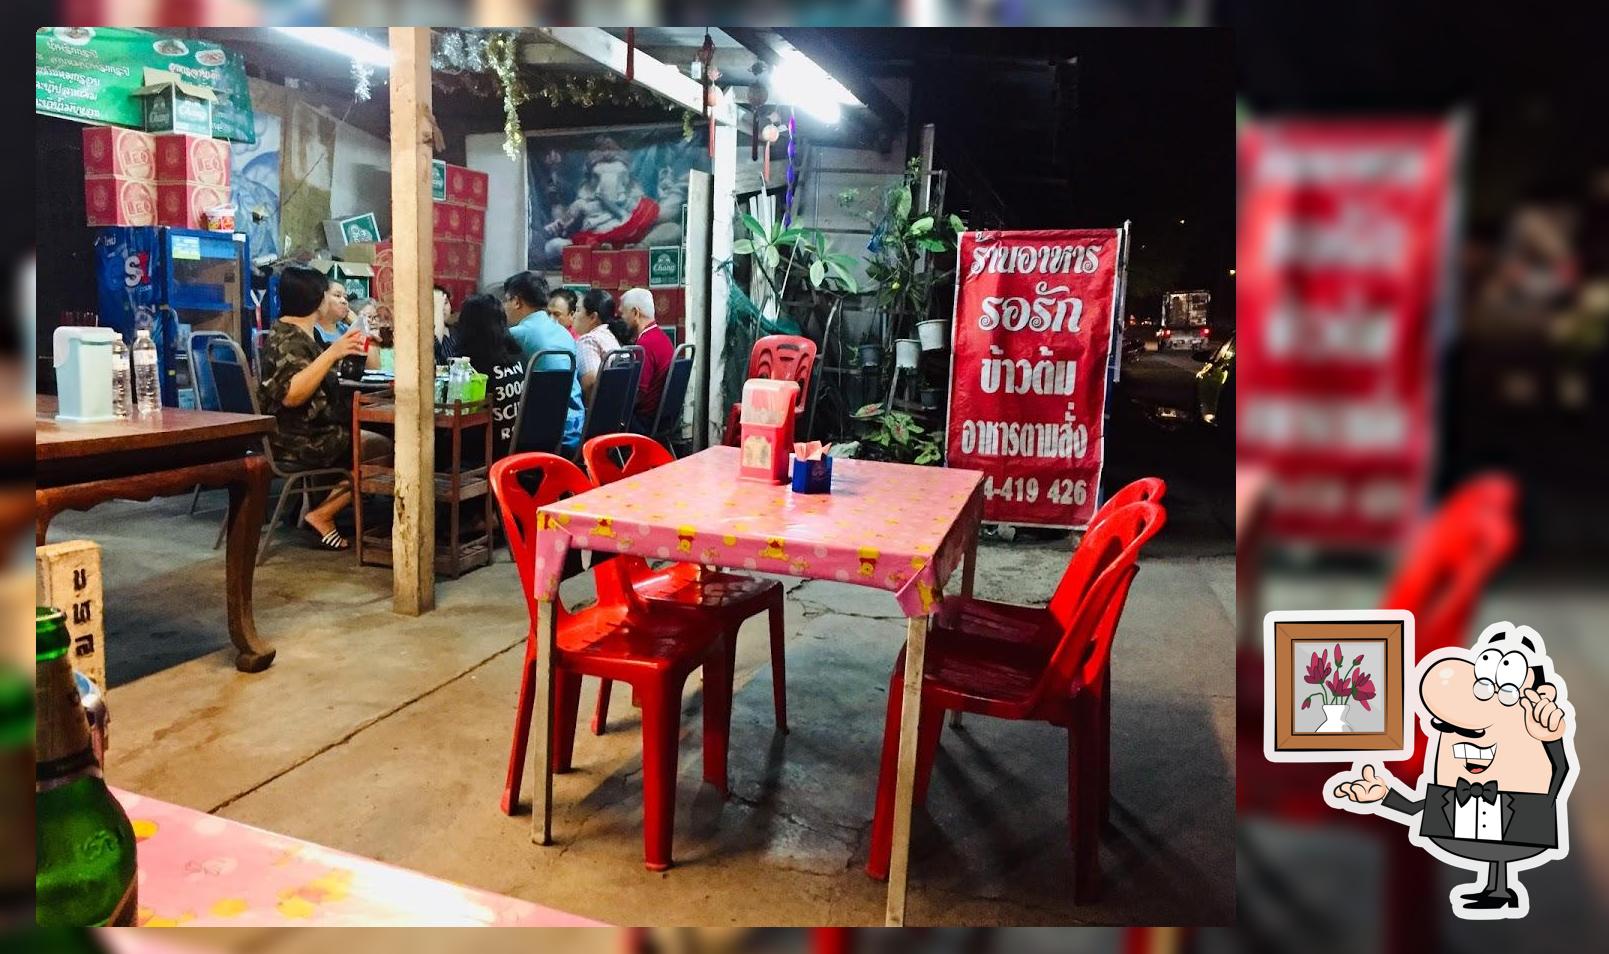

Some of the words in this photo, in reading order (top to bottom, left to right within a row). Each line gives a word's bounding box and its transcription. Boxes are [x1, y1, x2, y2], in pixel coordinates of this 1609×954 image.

[124, 151, 149, 165] LEO
[198, 158, 221, 171] LEO
[128, 201, 153, 214] LEO
[971, 230, 1102, 274] ร้านอาหาร
[653, 264, 675, 273] Chang
[978, 281, 1083, 332] รอรัก
[493, 361, 523, 379] SAN
[980, 345, 1077, 396] ข้าวต้ม
[492, 402, 521, 421] SCI
[961, 402, 1088, 459] อาหารตามสั่ง
[1047, 479, 1087, 505] 426
